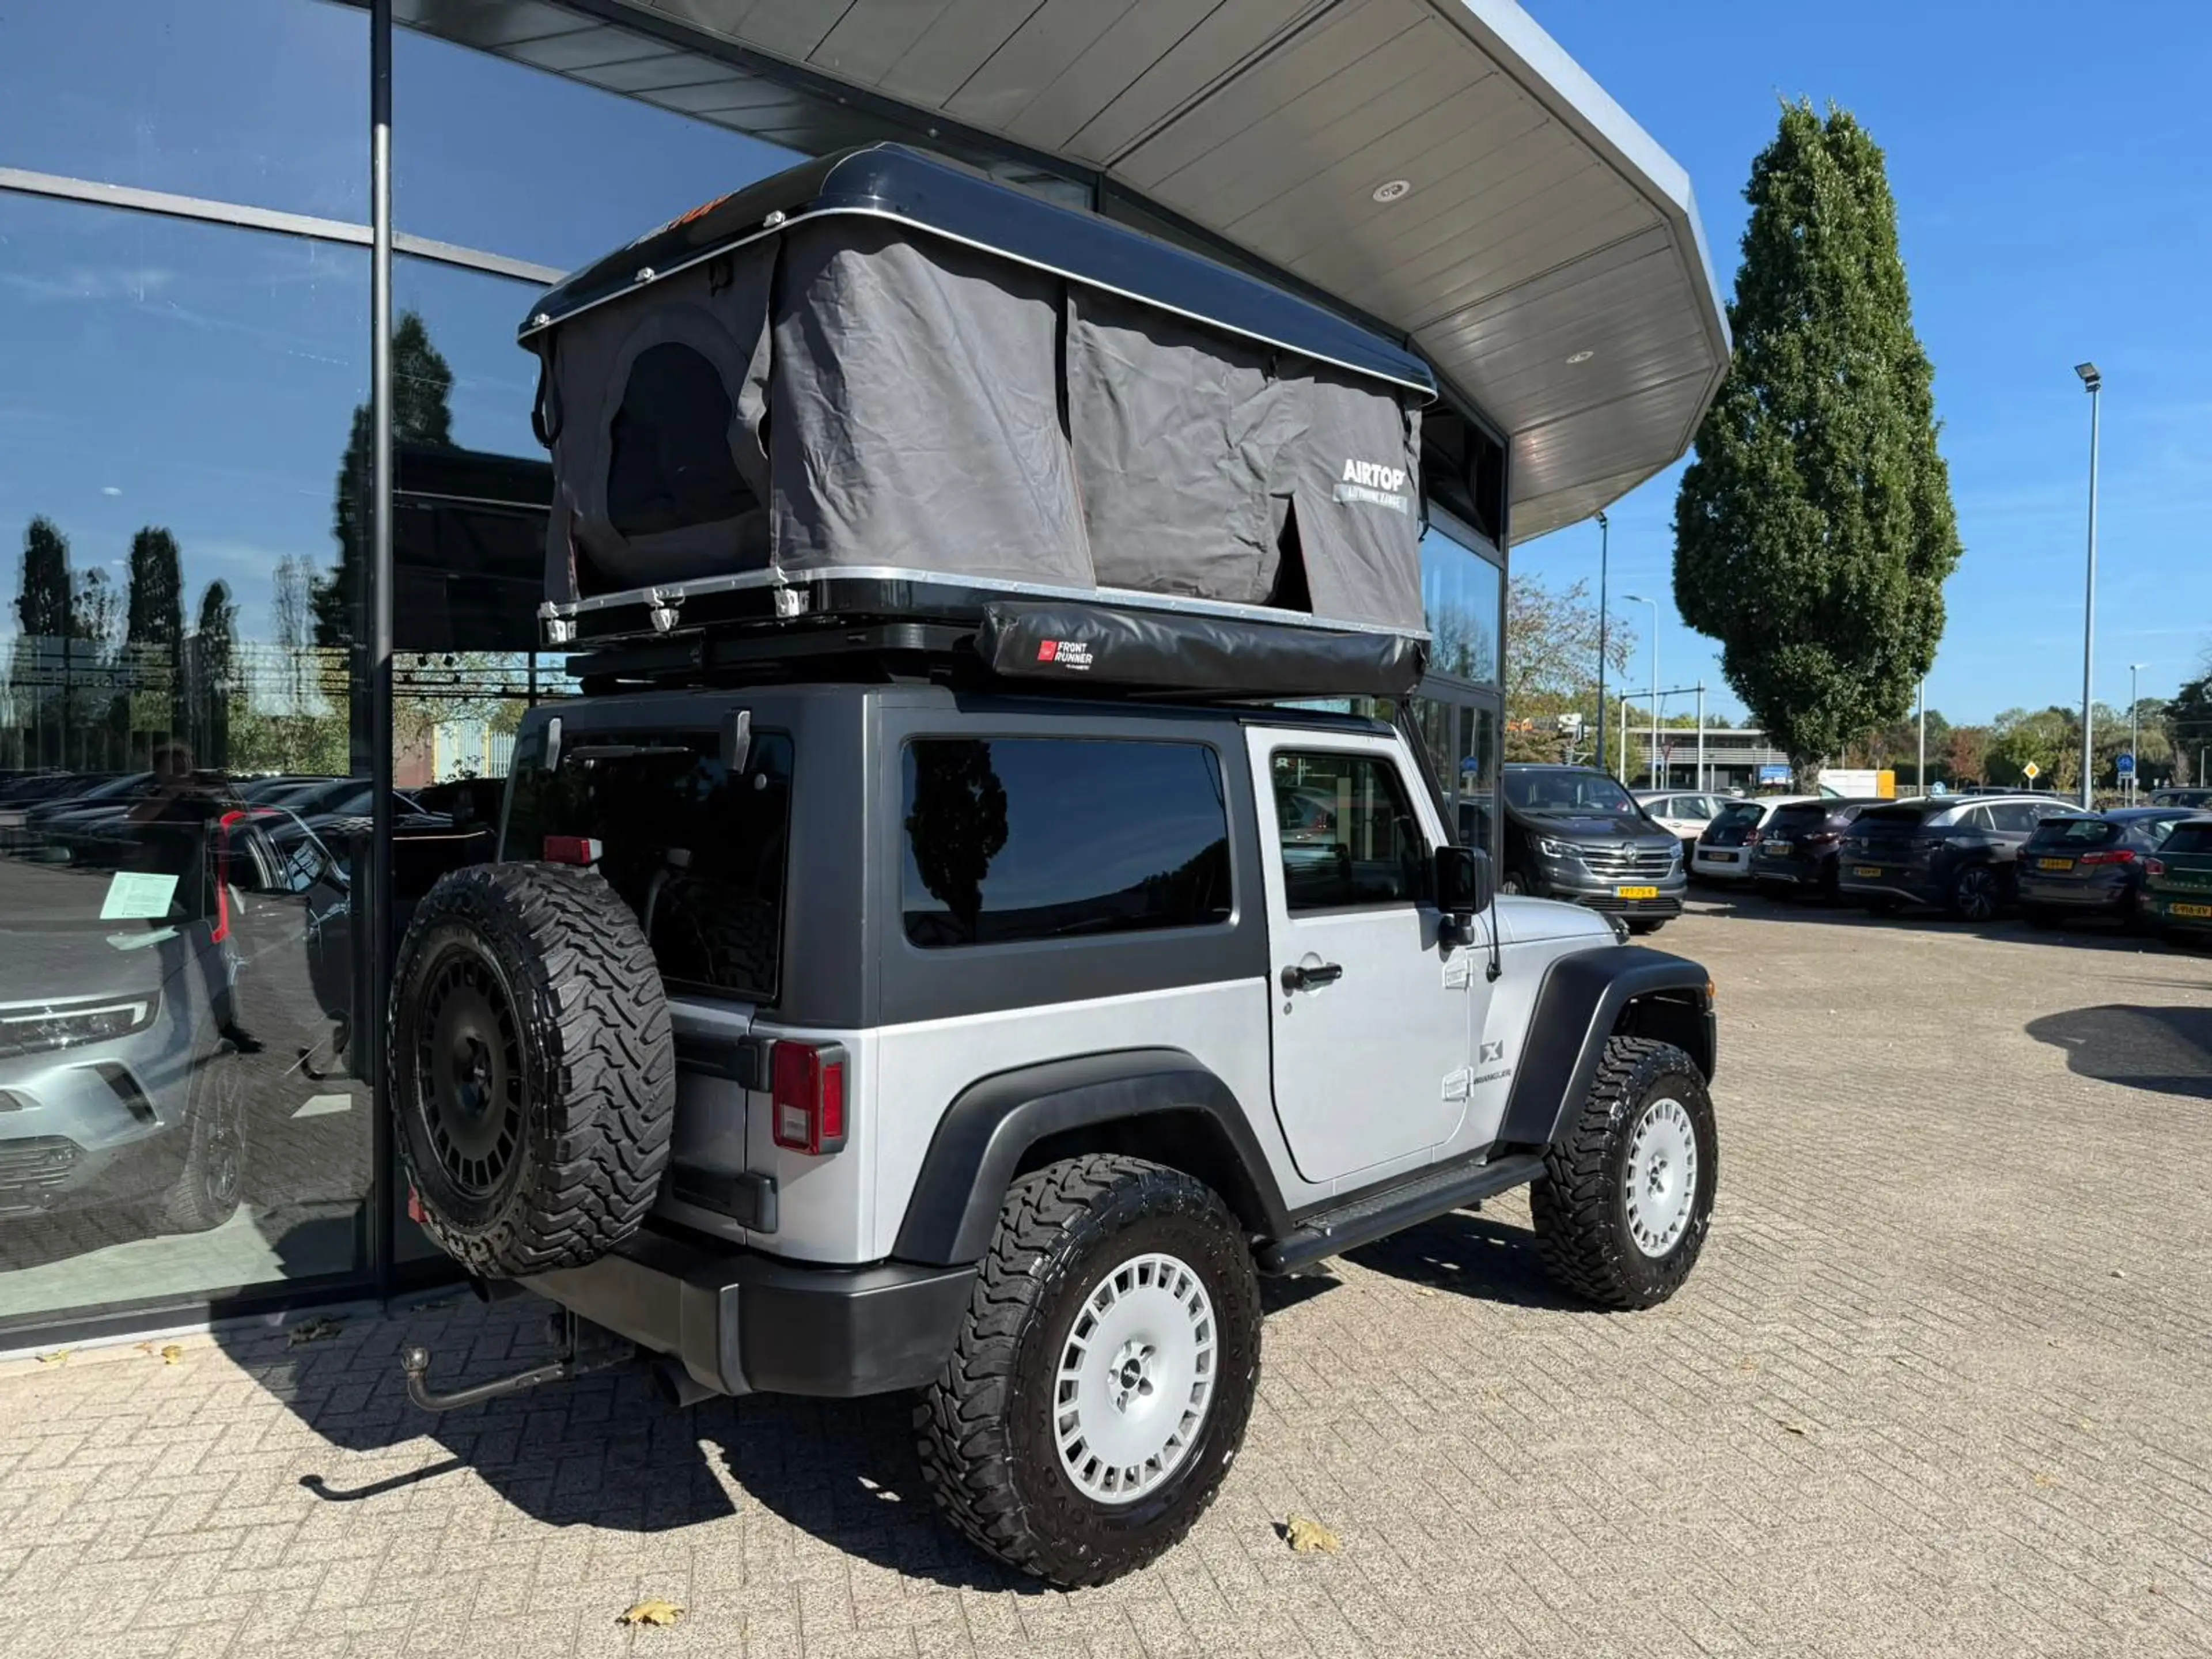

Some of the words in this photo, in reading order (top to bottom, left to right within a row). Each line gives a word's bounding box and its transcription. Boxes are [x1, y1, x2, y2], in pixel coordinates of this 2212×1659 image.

[1342, 459, 1405, 491] AIRTOP
[1058, 641, 1088, 652] FRONT
[1055, 652, 1093, 663] RUNNER
